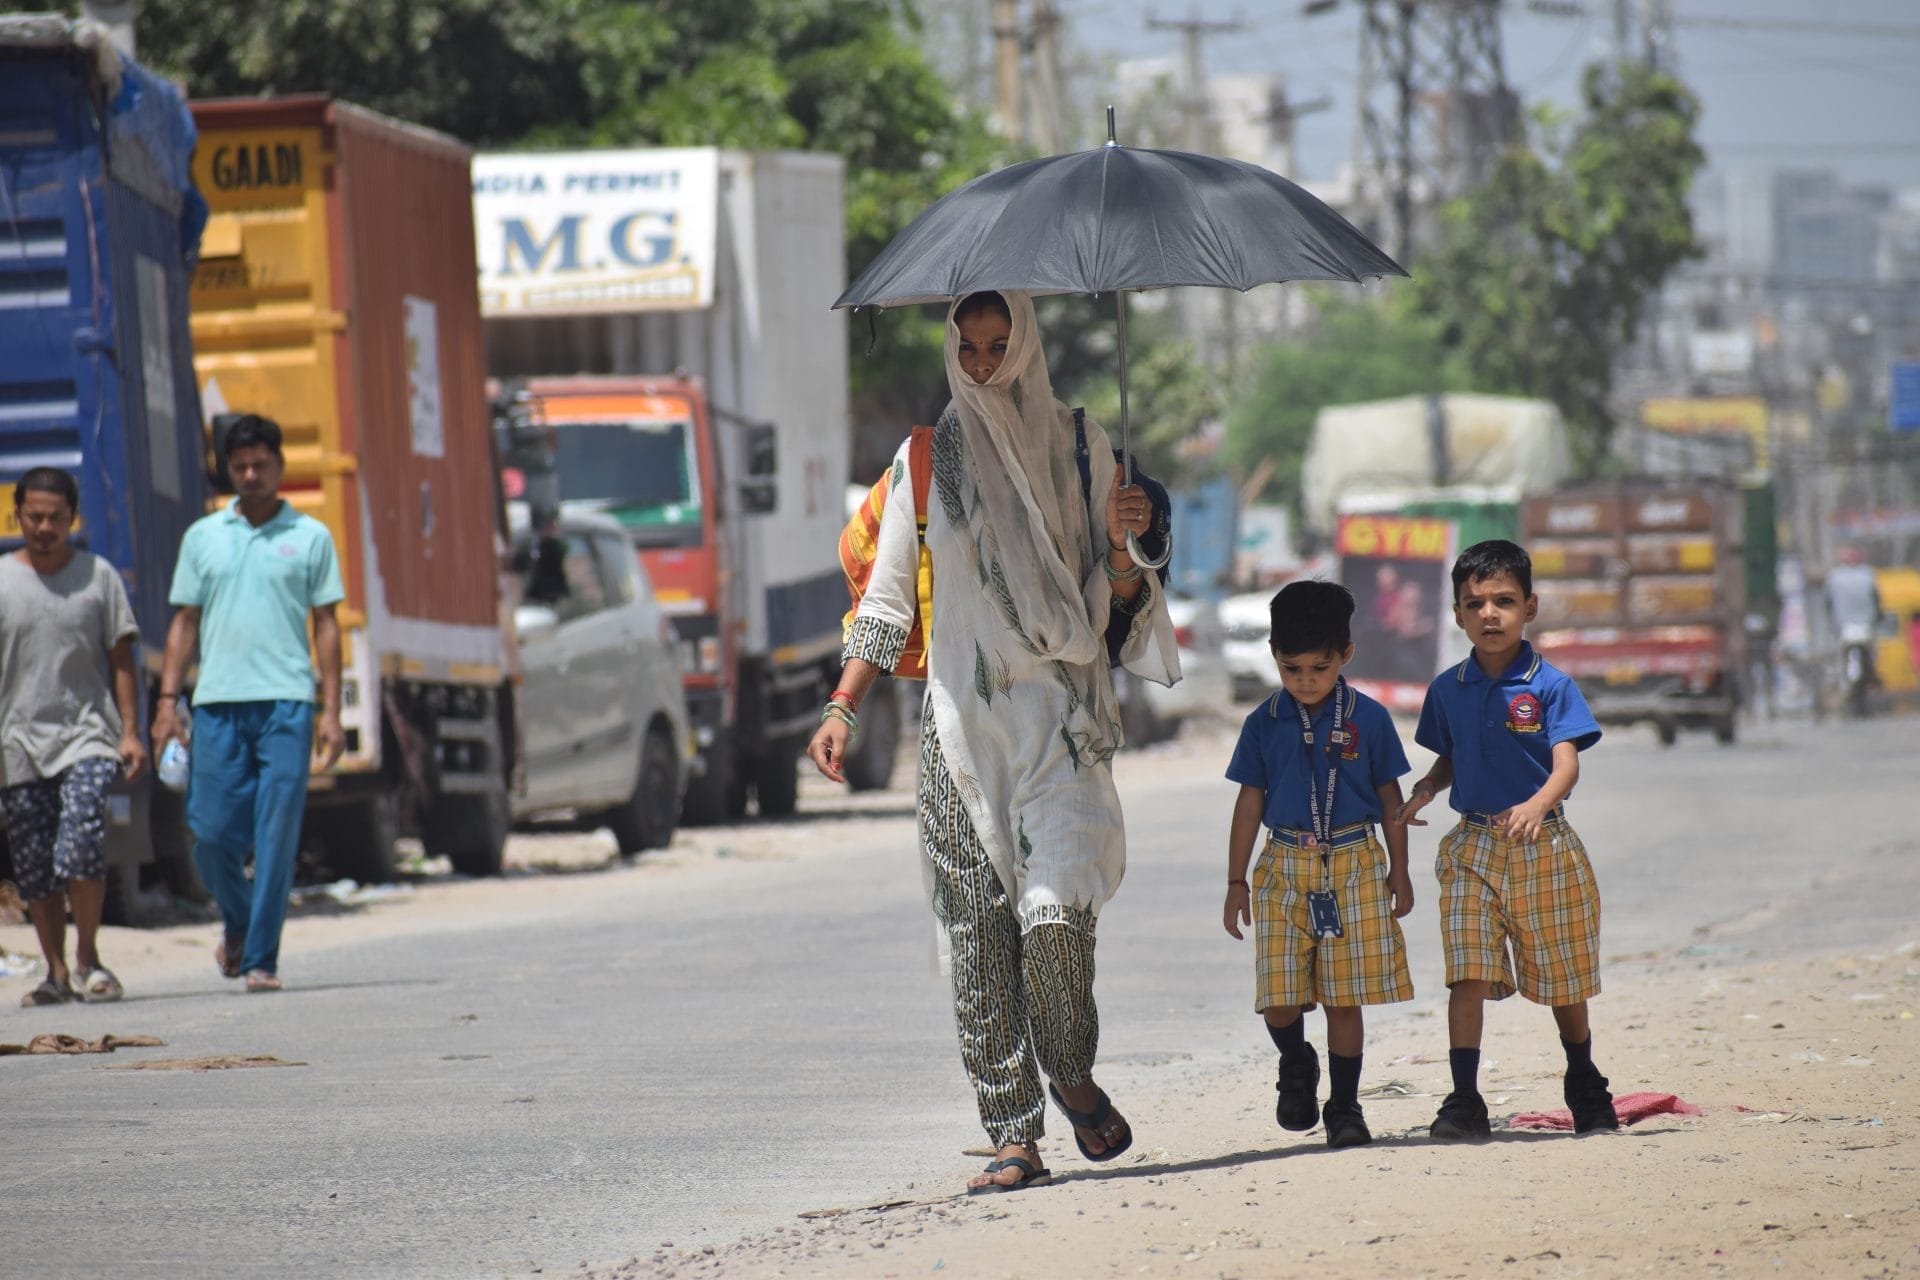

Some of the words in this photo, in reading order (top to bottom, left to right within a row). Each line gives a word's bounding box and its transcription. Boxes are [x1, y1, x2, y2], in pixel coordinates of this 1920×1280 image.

[212, 142, 303, 190] GAADI
[474, 173, 546, 193] NDIA
[564, 170, 683, 193] PERMIT
[1344, 519, 1443, 557] GYM
